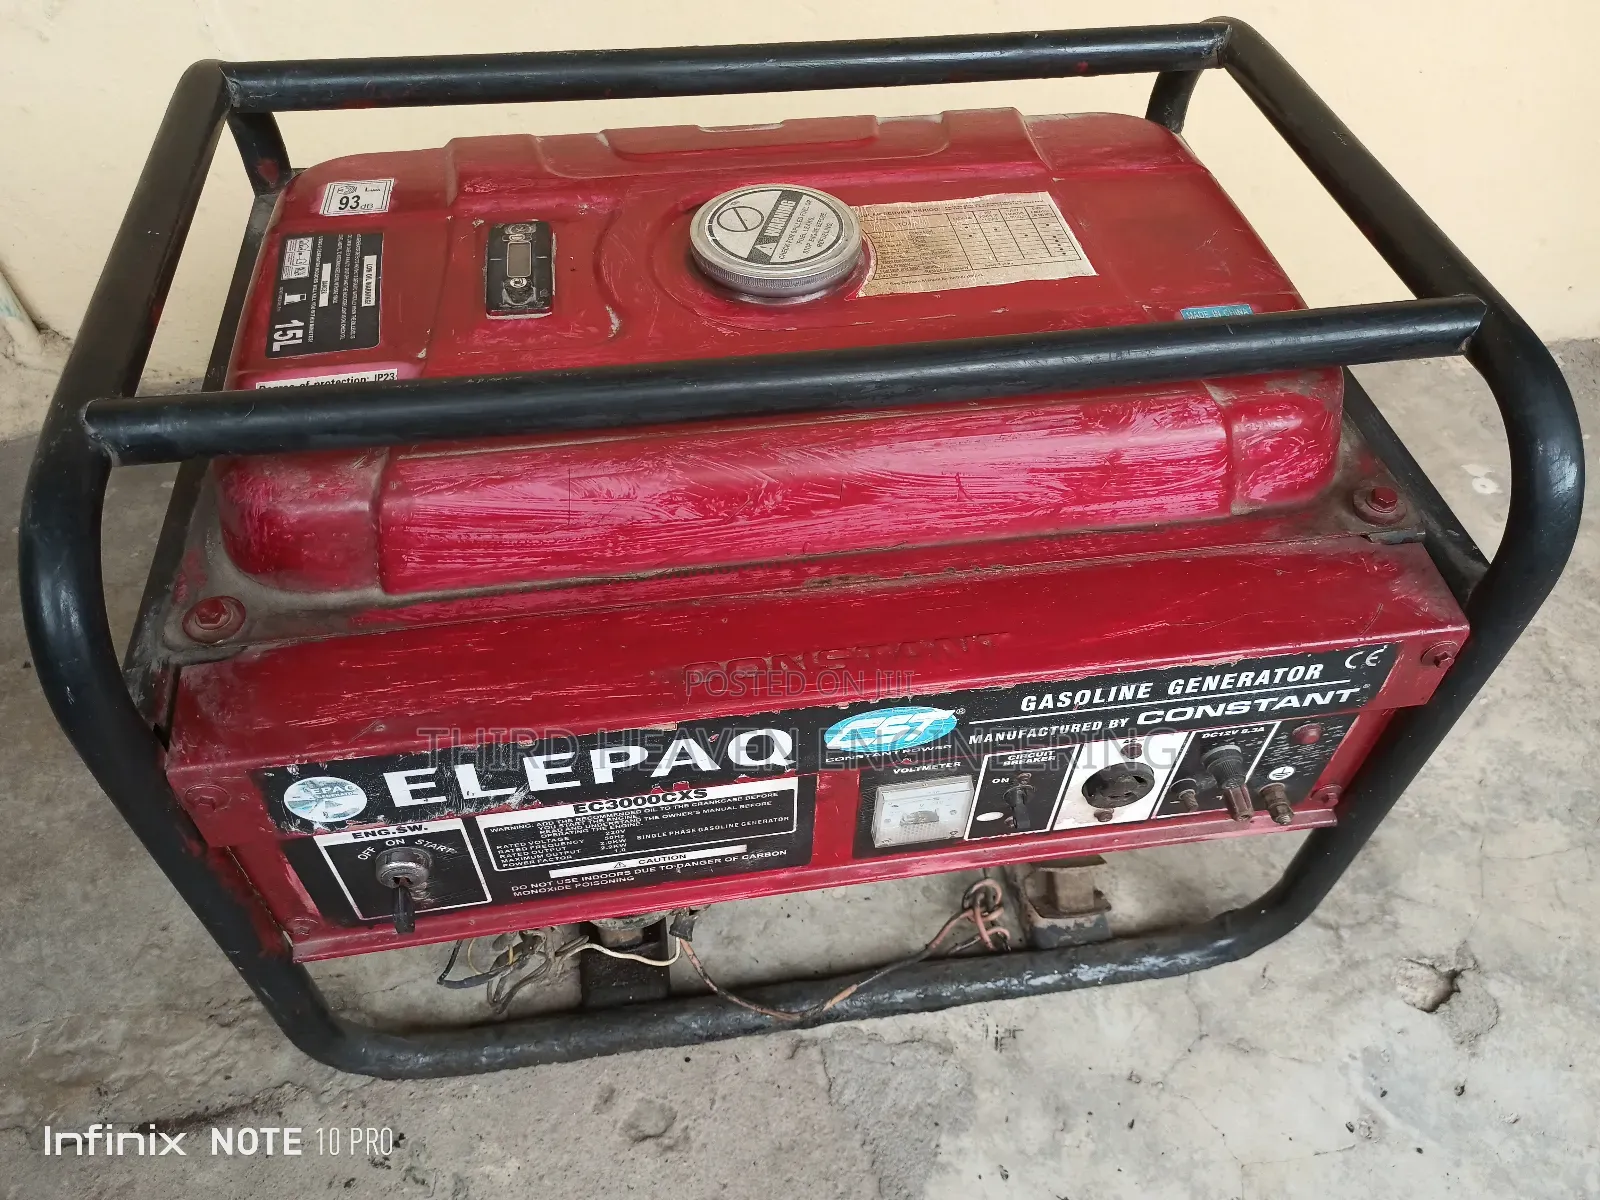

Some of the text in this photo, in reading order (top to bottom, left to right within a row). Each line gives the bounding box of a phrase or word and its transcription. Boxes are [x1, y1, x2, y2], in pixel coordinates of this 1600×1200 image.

[338, 195, 361, 210] 93
[763, 200, 797, 237] WARNING
[1185, 311, 1208, 319] MADE
[1223, 308, 1250, 316] CHINA
[273, 319, 305, 352] 15L
[1020, 682, 1154, 712] GASOLINE
[1167, 662, 1324, 696] GENERATOR
[968, 687, 1362, 745] MANUFACTURED BY CONSTANT
[1002, 755, 1057, 767] BREAKER
[1007, 750, 1056, 761] CIRCUIT
[382, 728, 798, 808] ELEPAQ
[893, 761, 962, 775] VOLTMETER
[572, 788, 708, 815] EC3000CXS
[661, 810, 701, 819] OWNER'S
[702, 805, 738, 815] MANUAL
[739, 800, 773, 810] BEFORE
[490, 823, 535, 833] WARNING:
[575, 809, 642, 822] RECOMMENDED
[691, 796, 743, 808] CRANKCASE
[745, 792, 779, 801] BEFORE
[352, 824, 429, 840] ENG.SW.
[540, 828, 589, 839] OPERATING
[636, 815, 790, 841] SINGLE PHASE GASOLINE GENERATOR
[357, 838, 458, 861] OFF ON START
[496, 842, 527, 850] RATED
[528, 836, 571, 846] VOLTAGE
[497, 846, 528, 854] RATED
[529, 839, 585, 850] FREQUENCY
[499, 851, 530, 859] RATED
[531, 846, 567, 855] OUTPUT
[500, 854, 544, 864] MAXIMUM
[545, 848, 583, 858] OUTPUT
[638, 853, 687, 866] CAUTION
[502, 859, 536, 868] POWER
[537, 855, 574, 863] FACTOR
[511, 849, 788, 892] DO NOT USE INDOORS DUE TO DANGER OF CARBON
[512, 875, 635, 898] MONOXIDE POISONING
